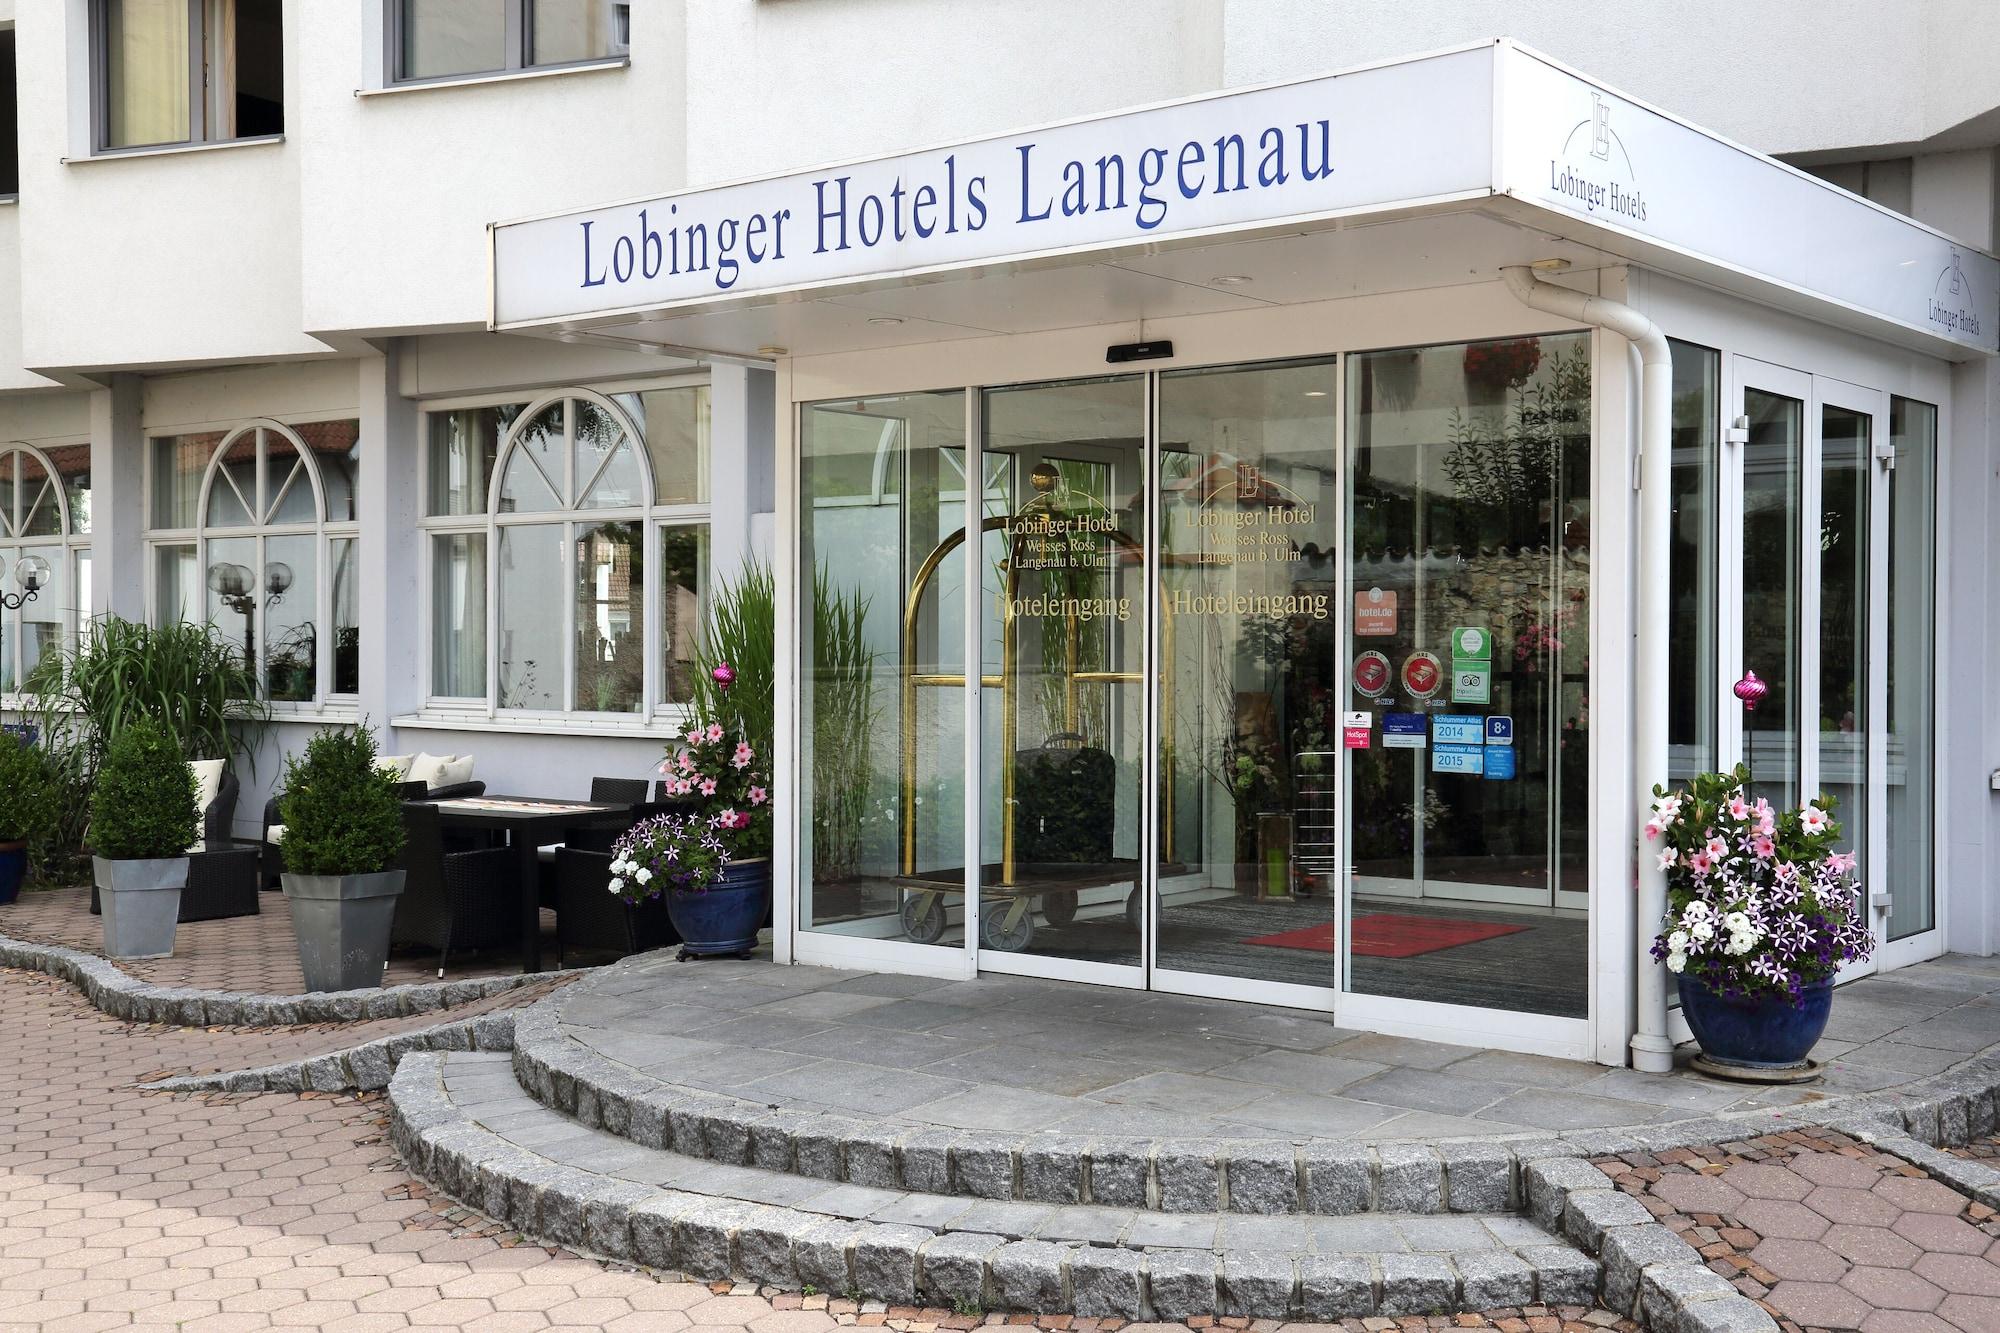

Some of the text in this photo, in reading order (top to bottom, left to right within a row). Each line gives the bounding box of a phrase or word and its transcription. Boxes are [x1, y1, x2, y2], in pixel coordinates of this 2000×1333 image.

[1551, 160, 1647, 222] Lobinger Hotels
[580, 118, 1335, 289] Lobinger Hotels Langenau
[1929, 298, 1980, 336] Lobinger Hotels
[1005, 513, 1119, 537] Lobinger Hotel
[1186, 504, 1316, 530] Lobinger Hotel
[1026, 538, 1096, 553] Weisses Ross
[1211, 531, 1289, 546] Weisses Ross
[1015, 553, 1108, 571] Langenau b. Ulm
[1198, 548, 1301, 566] Langenau b. Ulm
[995, 592, 1131, 621] Hoteleingang
[1173, 589, 1328, 619] Hoteleingang
[1359, 607, 1393, 618] hotel.de
[1434, 716, 1482, 724] Schlummer Atlas
[1346, 730, 1368, 739] HotSpot
[1438, 726, 1464, 737] 2014
[1433, 744, 1482, 754] Schlummer Atlas
[1438, 755, 1463, 767] 2015
